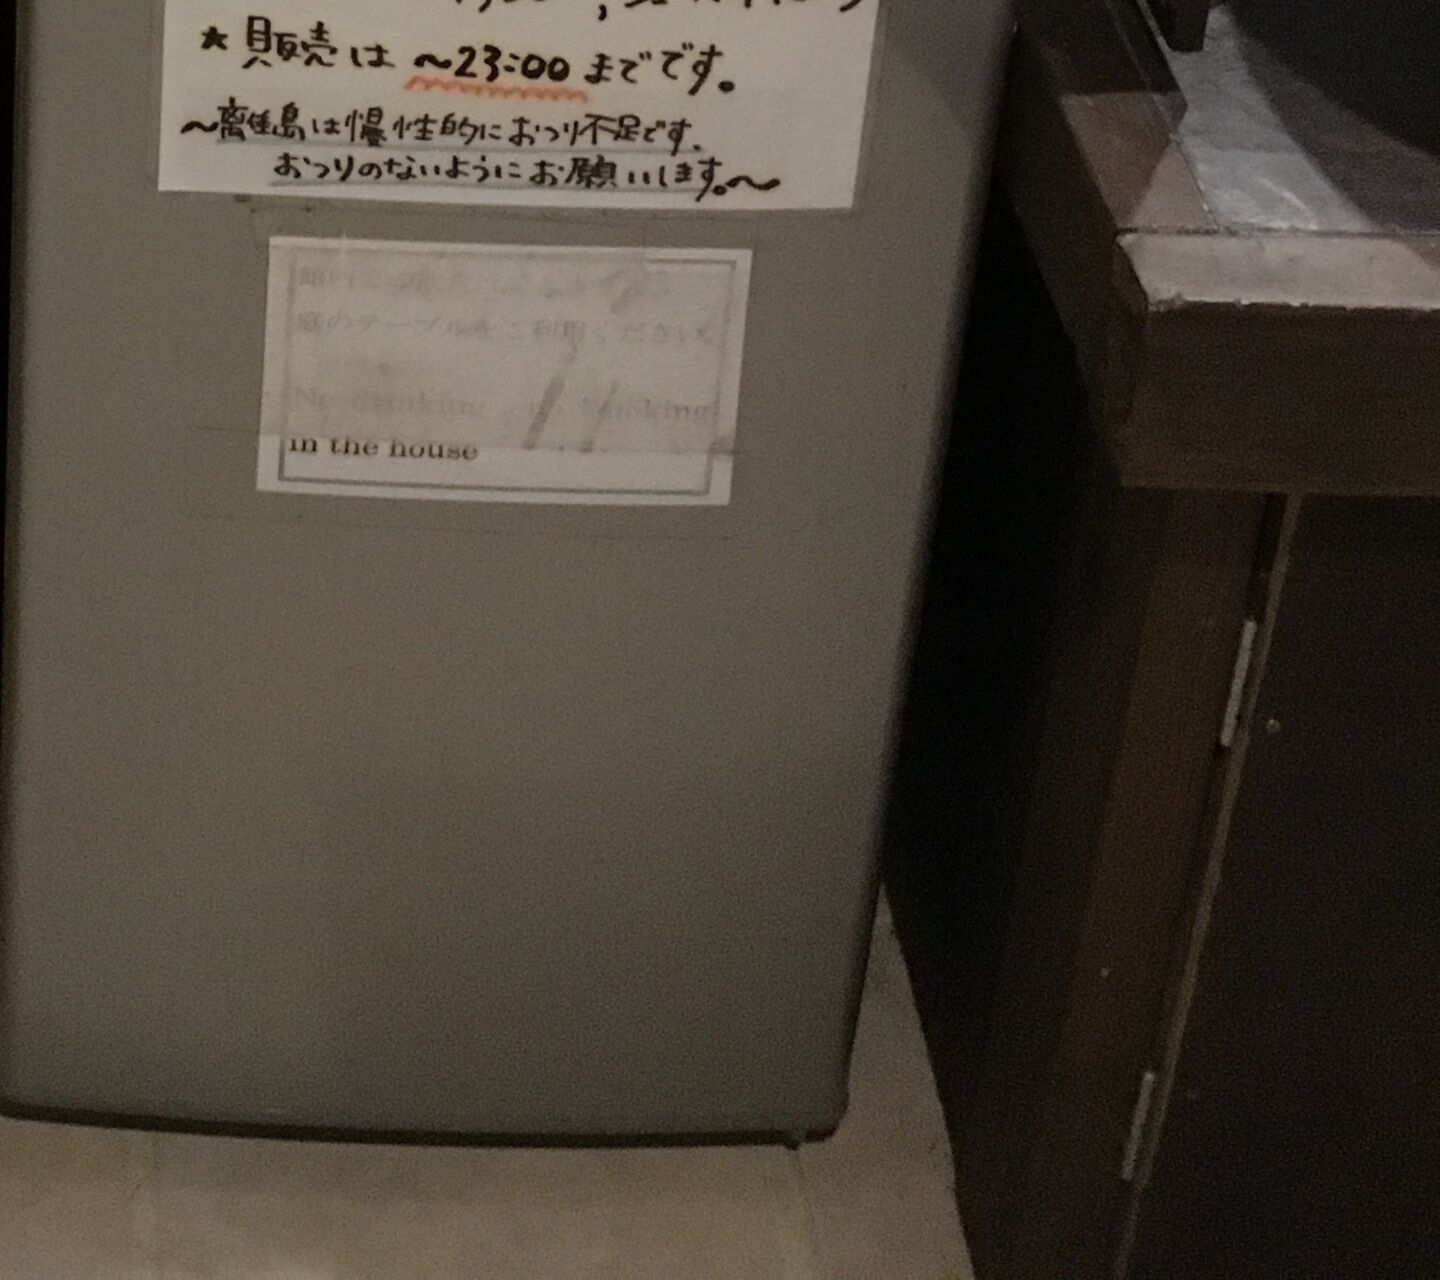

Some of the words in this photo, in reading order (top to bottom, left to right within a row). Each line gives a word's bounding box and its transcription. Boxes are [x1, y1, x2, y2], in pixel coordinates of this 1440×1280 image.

[289, 436, 317, 453] in
[329, 436, 379, 456] the
[388, 436, 479, 461] house
